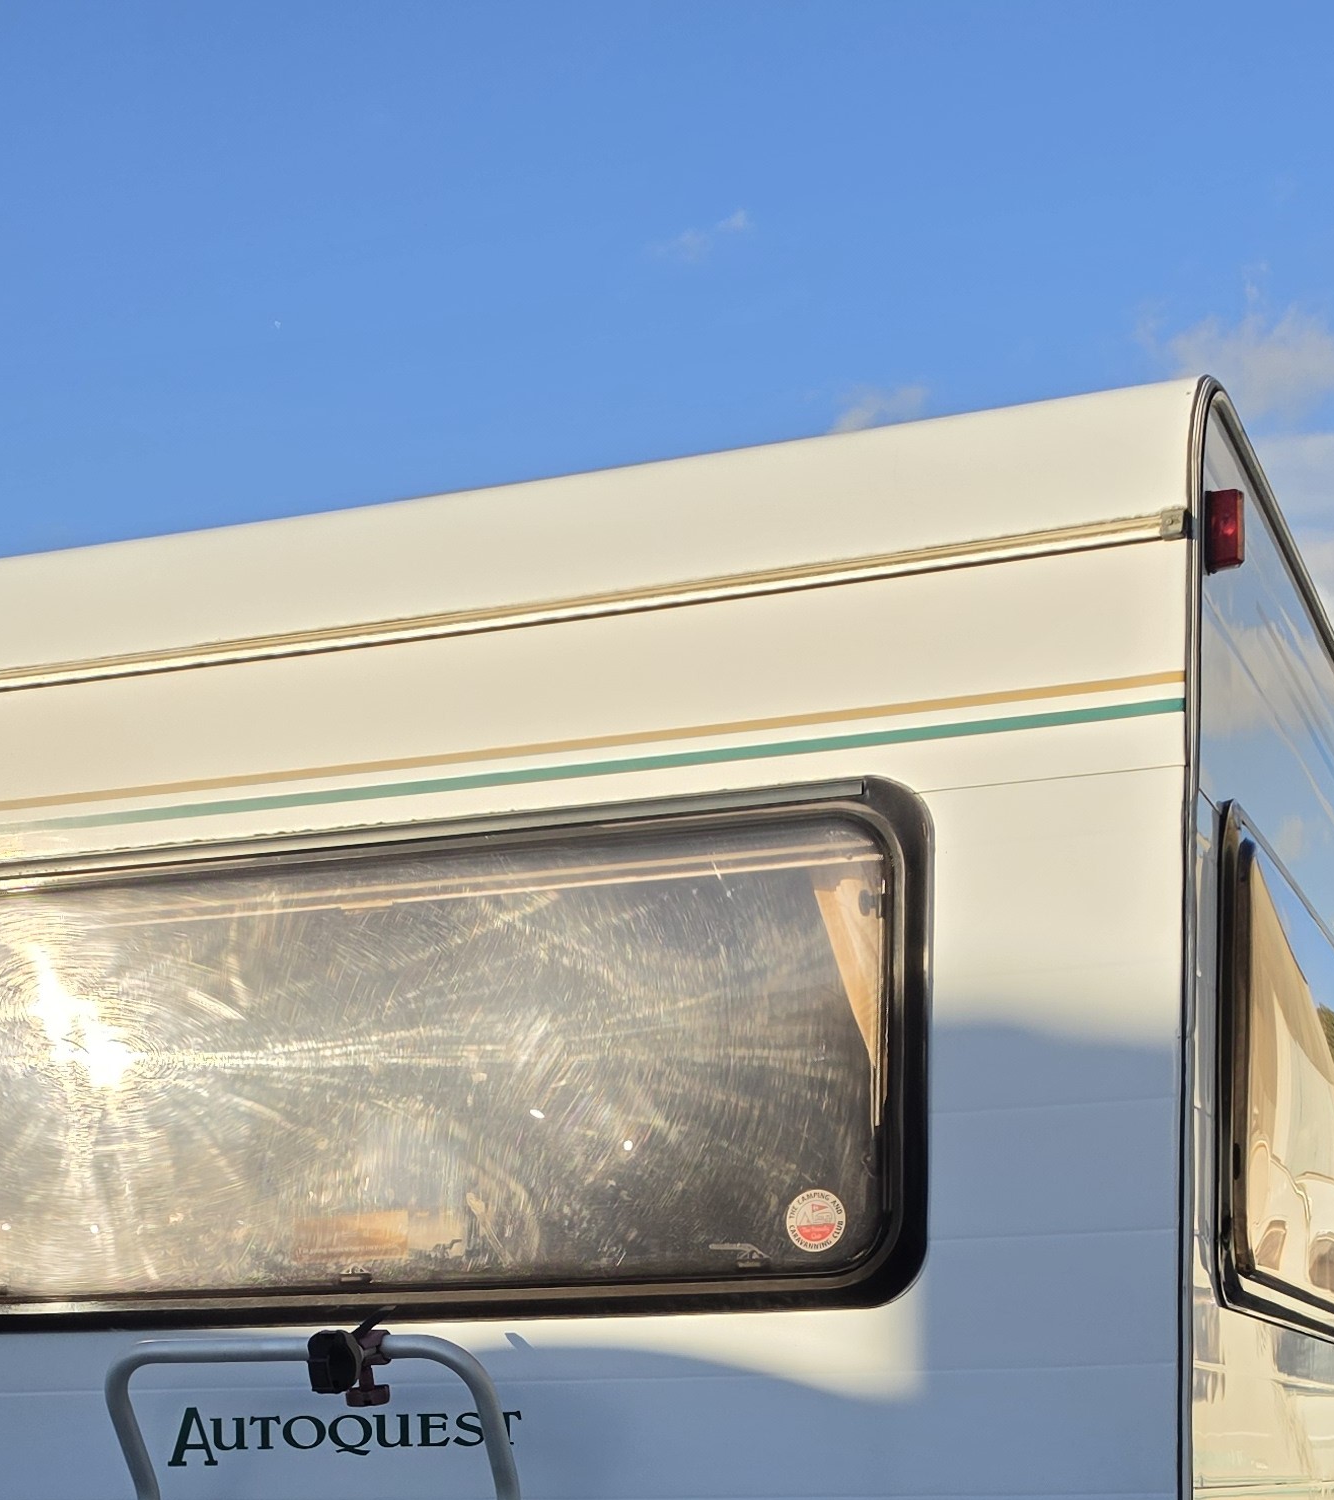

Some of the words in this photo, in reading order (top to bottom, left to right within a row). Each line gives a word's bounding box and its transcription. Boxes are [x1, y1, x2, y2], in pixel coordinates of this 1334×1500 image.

[789, 1206, 798, 1218] THE
[797, 1192, 830, 1205] CAMPING
[830, 1200, 843, 1215] AND
[789, 1224, 832, 1249] CARAVANNING
[832, 1220, 843, 1238] CLUB
